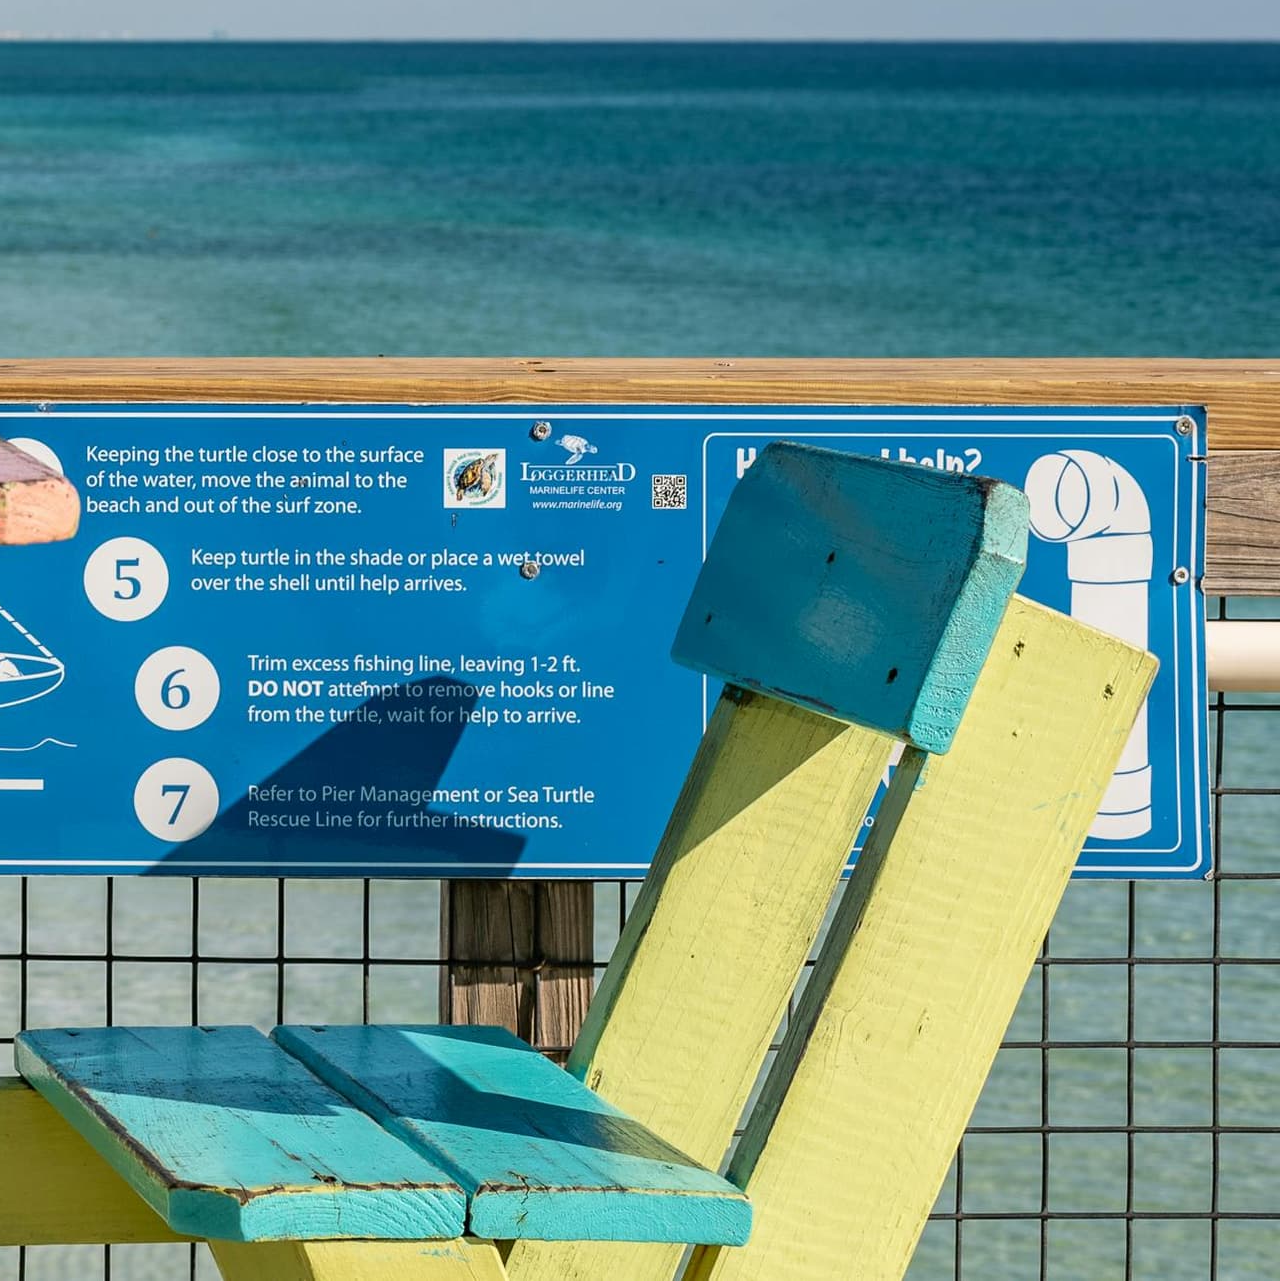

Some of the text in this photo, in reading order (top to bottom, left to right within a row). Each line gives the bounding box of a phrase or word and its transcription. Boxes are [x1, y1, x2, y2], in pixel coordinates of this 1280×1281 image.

[86, 445, 424, 467] Keeping the turtle close to the surface
[86, 470, 408, 492] of the water, move the animal to the
[520, 461, 636, 482] LOGGERHEAD
[529, 485, 626, 495] MARINELIFE CENTER
[86, 495, 362, 514] beach and out of the surf zone.
[532, 499, 623, 512] www.marinelife.org
[191, 548, 585, 570] Keep turtle in the shade or place a wet towel
[114, 557, 142, 600] 5
[190, 573, 467, 596] over the shell until help arrives.
[247, 654, 581, 676] Trim excess fishing line, leaving 1-2 ft.
[160, 668, 191, 710] 6
[248, 680, 615, 702] DO NOT attempt to remove hooks or line
[247, 705, 581, 727] from the turtle, wait for help to arrive.
[161, 784, 191, 825] 7
[248, 785, 595, 807] Refer to Pier Management or Sea Turtle
[248, 810, 563, 828] Rescue Line for further instructions.
